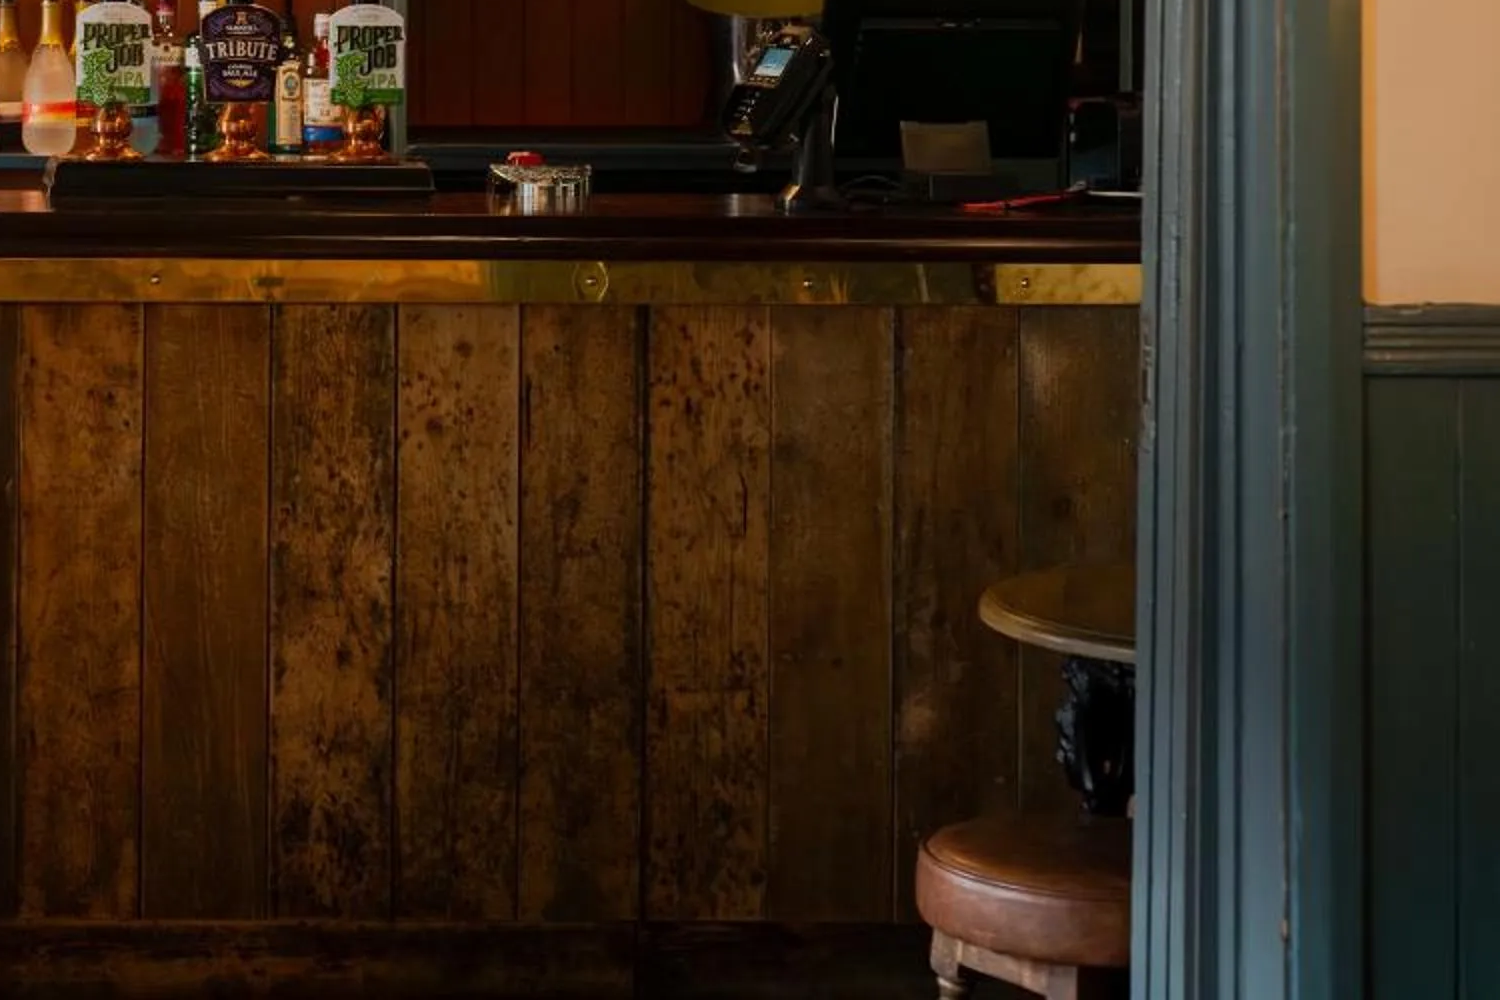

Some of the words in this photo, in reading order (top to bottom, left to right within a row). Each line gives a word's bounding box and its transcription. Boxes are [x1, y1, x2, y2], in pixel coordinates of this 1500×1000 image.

[82, 23, 151, 50] PROPER
[334, 26, 404, 53] PROPER
[106, 42, 144, 73] JOB
[205, 40, 279, 61] TRIBUTE
[360, 44, 397, 76] JOB
[368, 73, 397, 88] IPA
